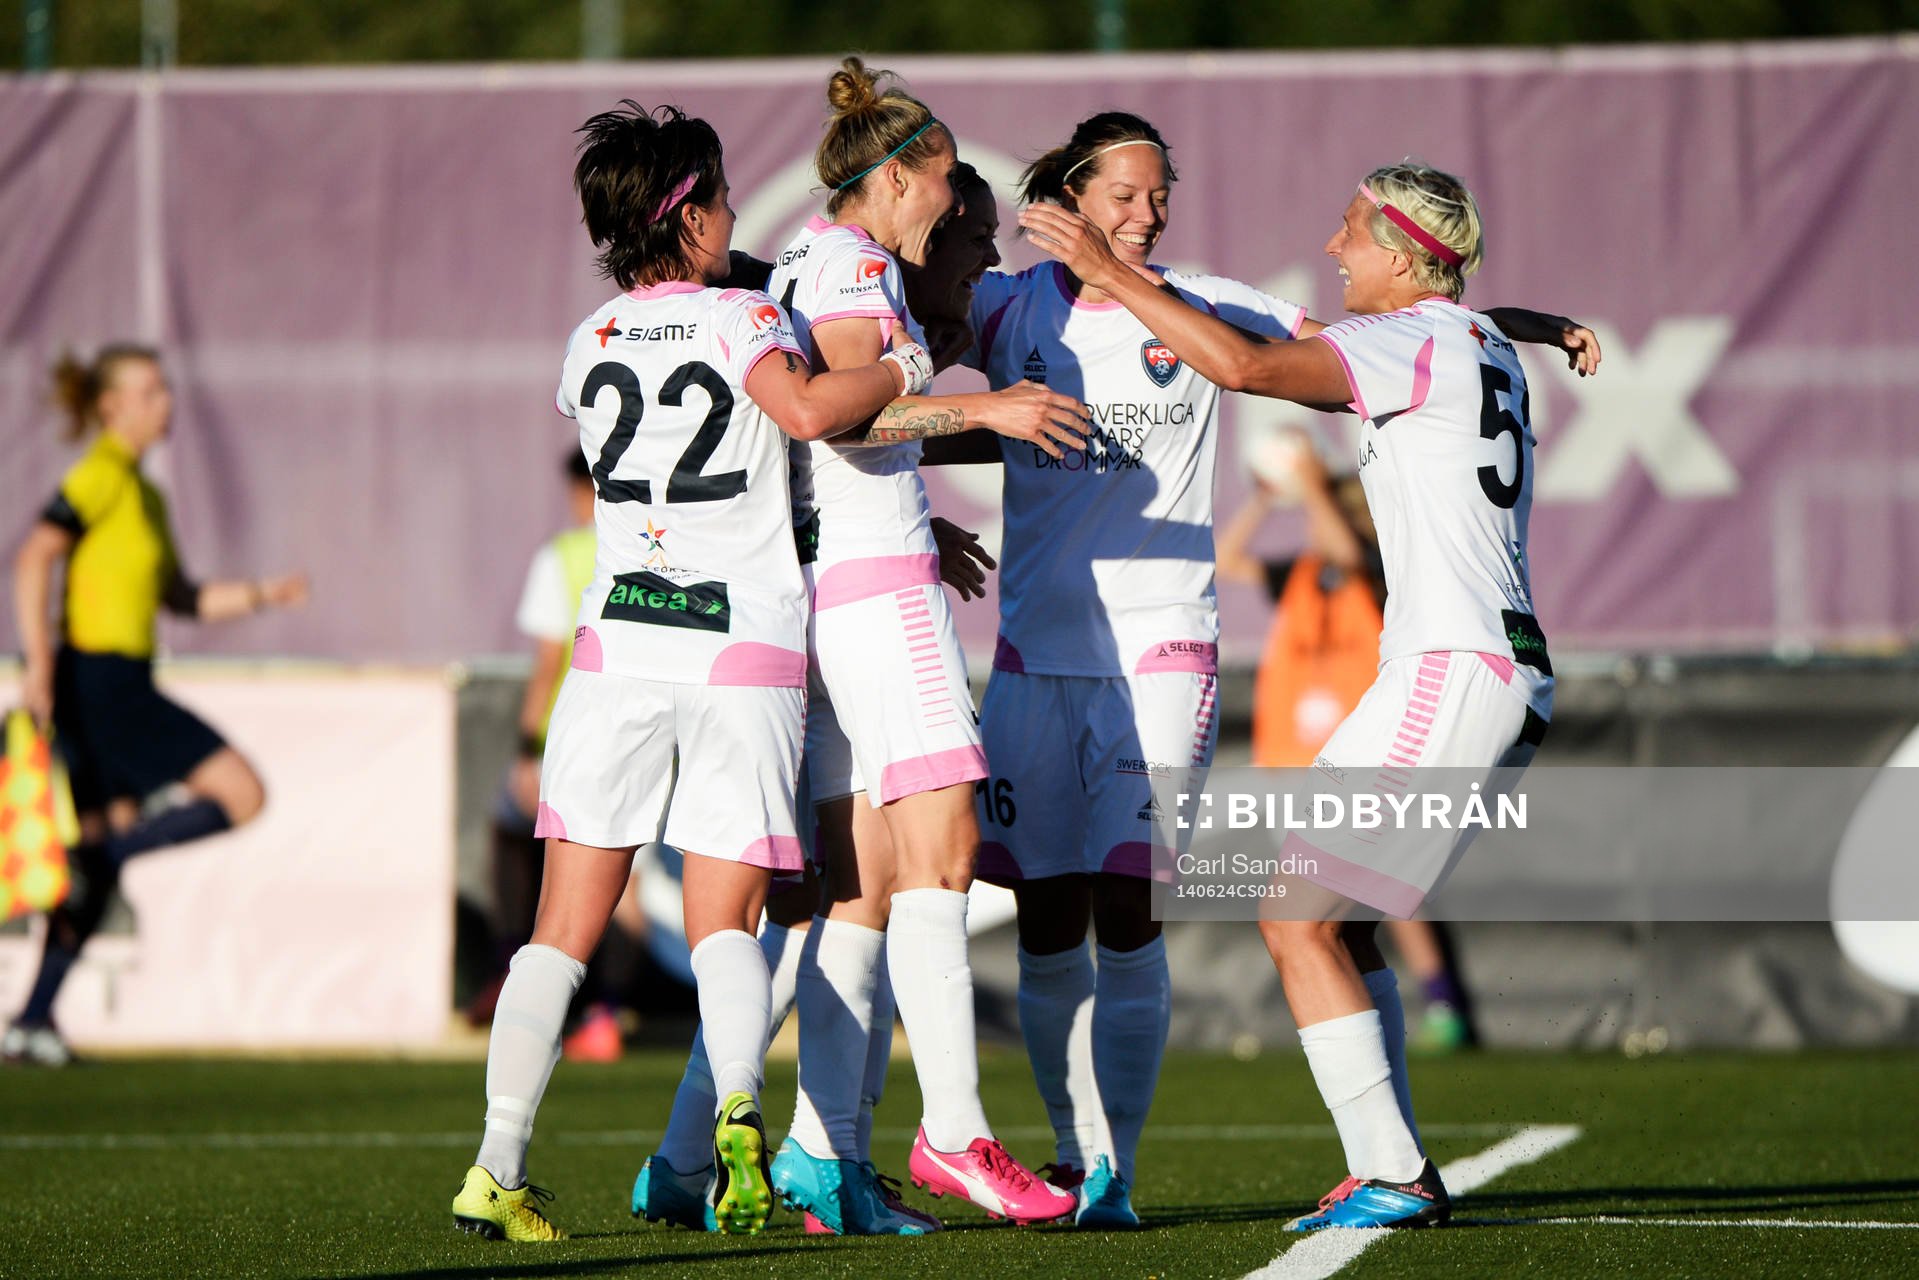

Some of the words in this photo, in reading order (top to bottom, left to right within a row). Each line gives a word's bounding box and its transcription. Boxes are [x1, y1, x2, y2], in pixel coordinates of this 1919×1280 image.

[839, 283, 880, 295] SVENSKA
[1083, 402, 1195, 425] RVERKLIGA
[579, 360, 748, 505] 22
[609, 584, 689, 612] akea
[1169, 642, 1204, 654] SELECT
[1116, 758, 1173, 776] SWEROCK
[975, 777, 1017, 828] 16
[1136, 811, 1165, 823] SELECT
